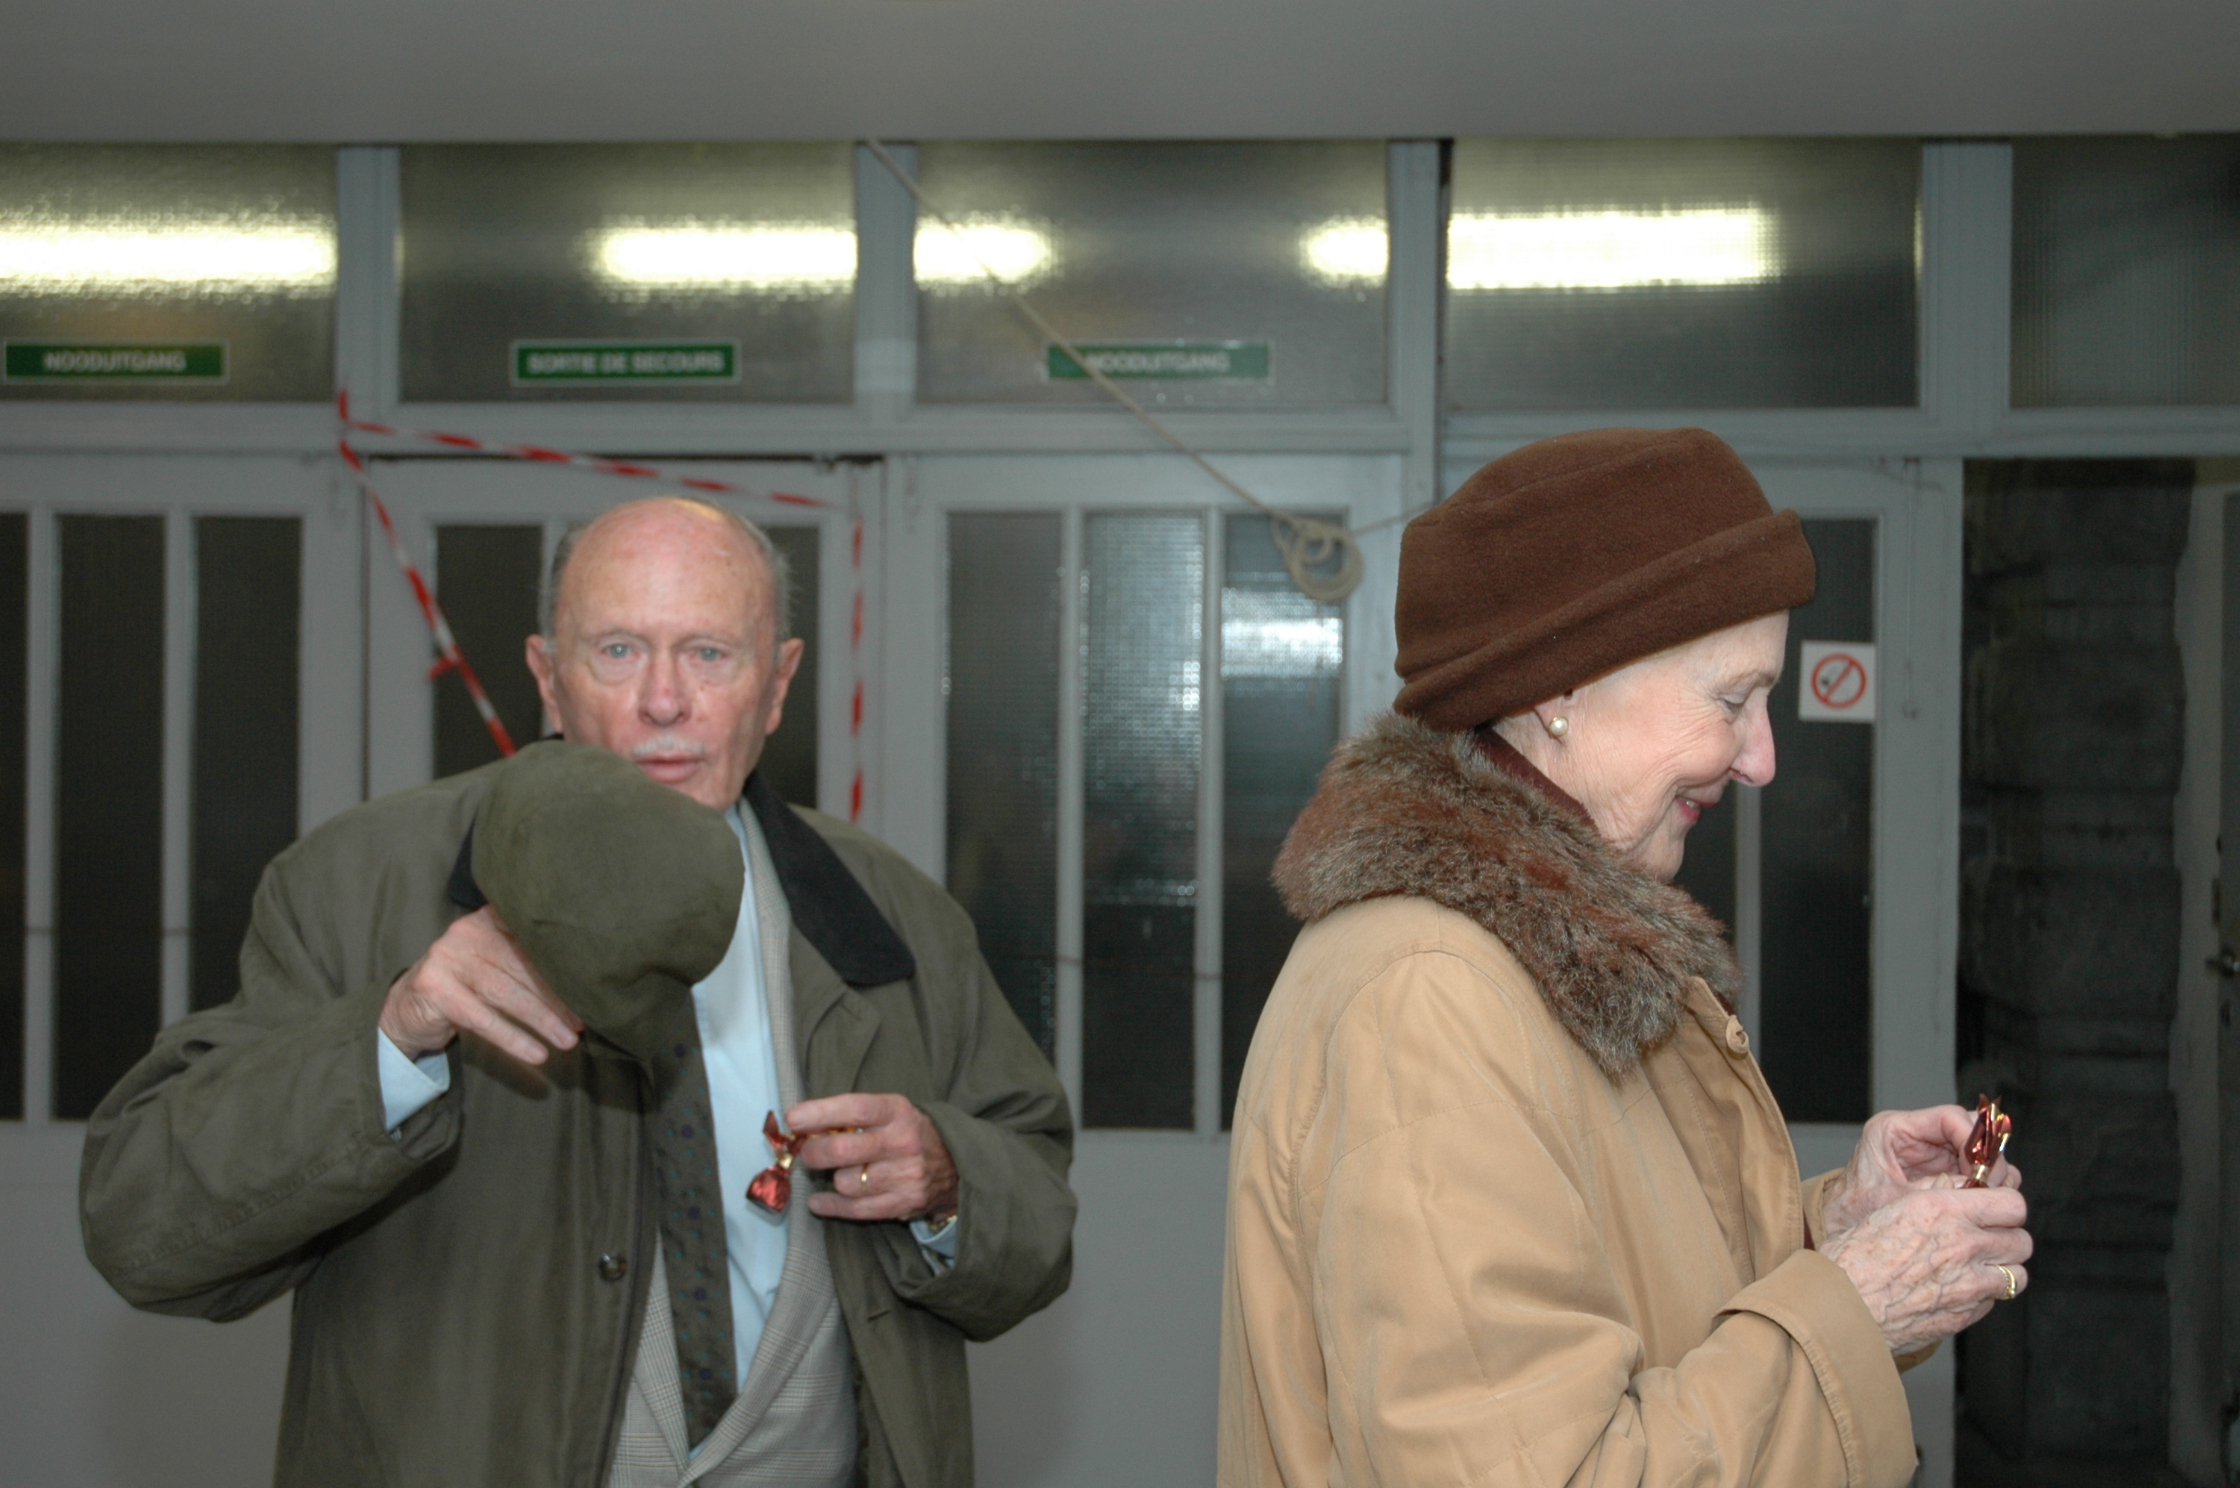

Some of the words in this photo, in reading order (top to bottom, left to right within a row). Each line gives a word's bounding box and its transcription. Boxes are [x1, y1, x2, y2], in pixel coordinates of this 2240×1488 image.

[44, 350, 187, 372] NOODUITGANG
[527, 351, 597, 373] SORTIE
[600, 351, 628, 373] DE
[632, 350, 725, 372] SECOURS
